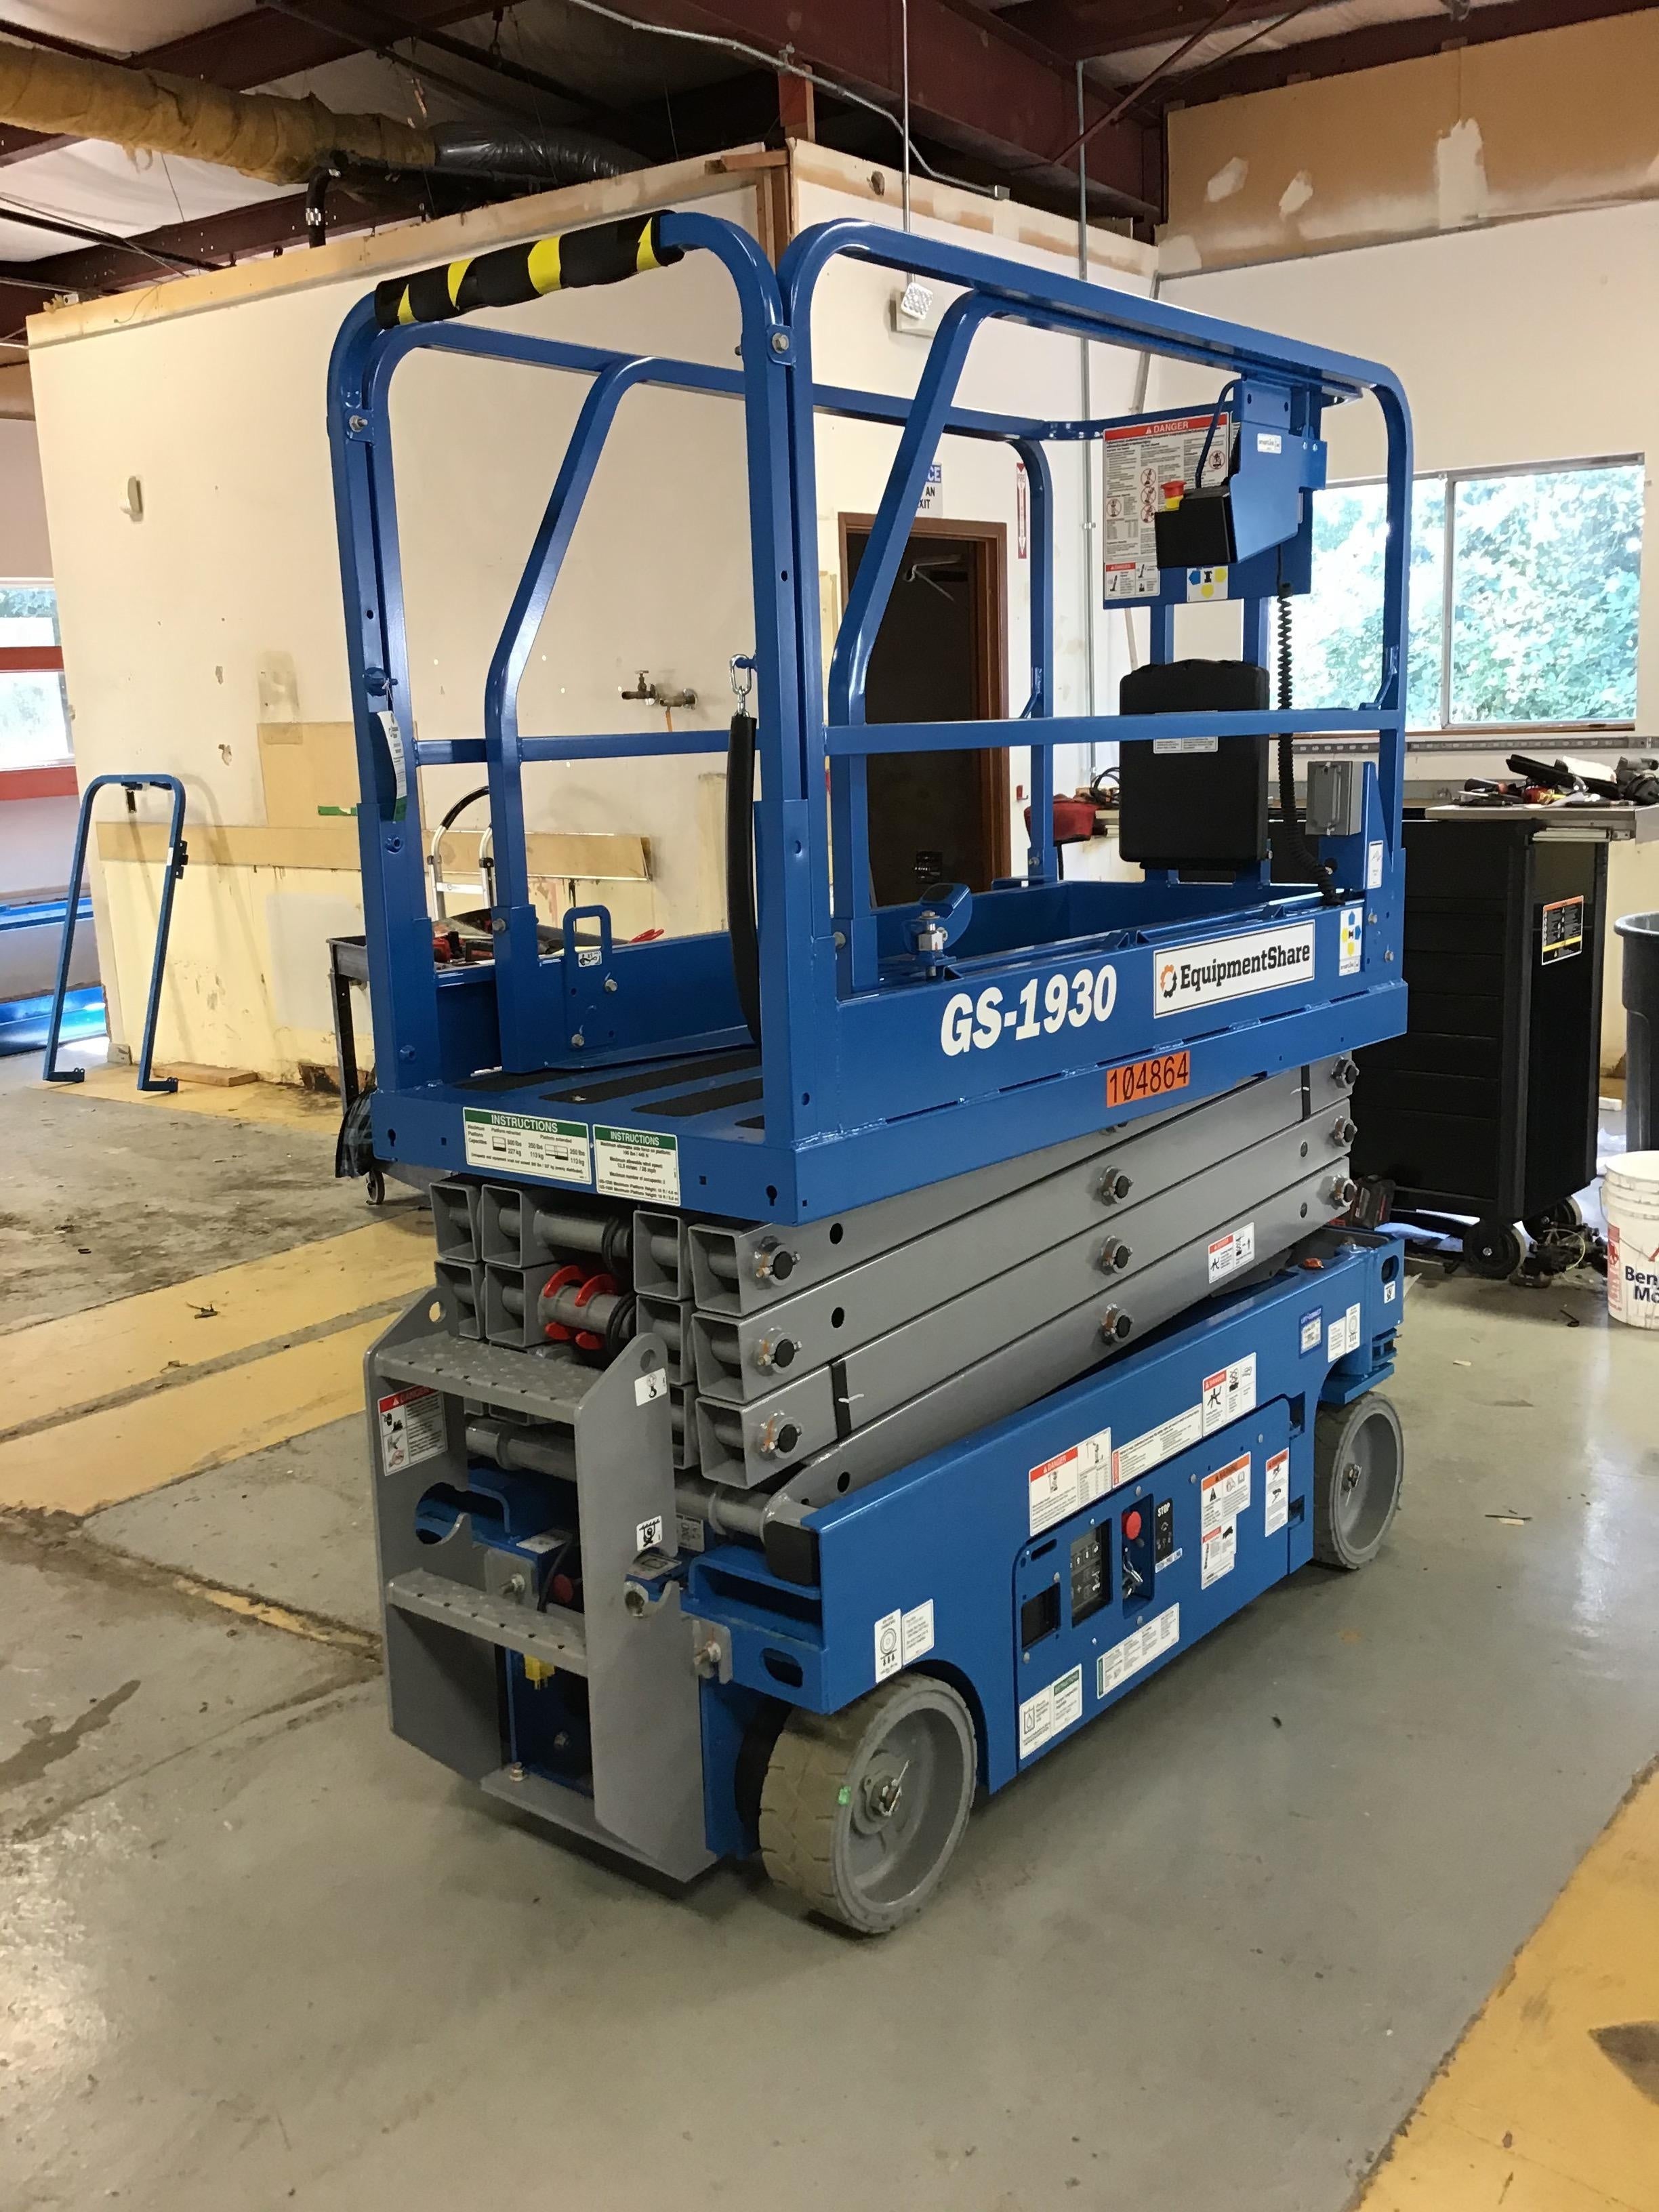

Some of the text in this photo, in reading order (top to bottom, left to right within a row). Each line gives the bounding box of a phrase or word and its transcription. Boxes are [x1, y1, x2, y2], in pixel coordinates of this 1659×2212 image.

[1153, 421, 1189, 433] DANGER
[925, 486, 935, 497] AN
[919, 498, 930, 509] XIT
[1180, 944, 1311, 990] EquipmentShare
[941, 964, 1117, 1057] GS-1930
[1109, 1052, 1189, 1104] 104864
[491, 1114, 558, 1133] INSTRUCTIONS
[610, 1131, 660, 1146] INSTRUCTIONS
[1625, 1265, 1659, 1288] Ben
[1047, 1454, 1067, 1470] DANGER
[1158, 1502, 1170, 1517] STOP
